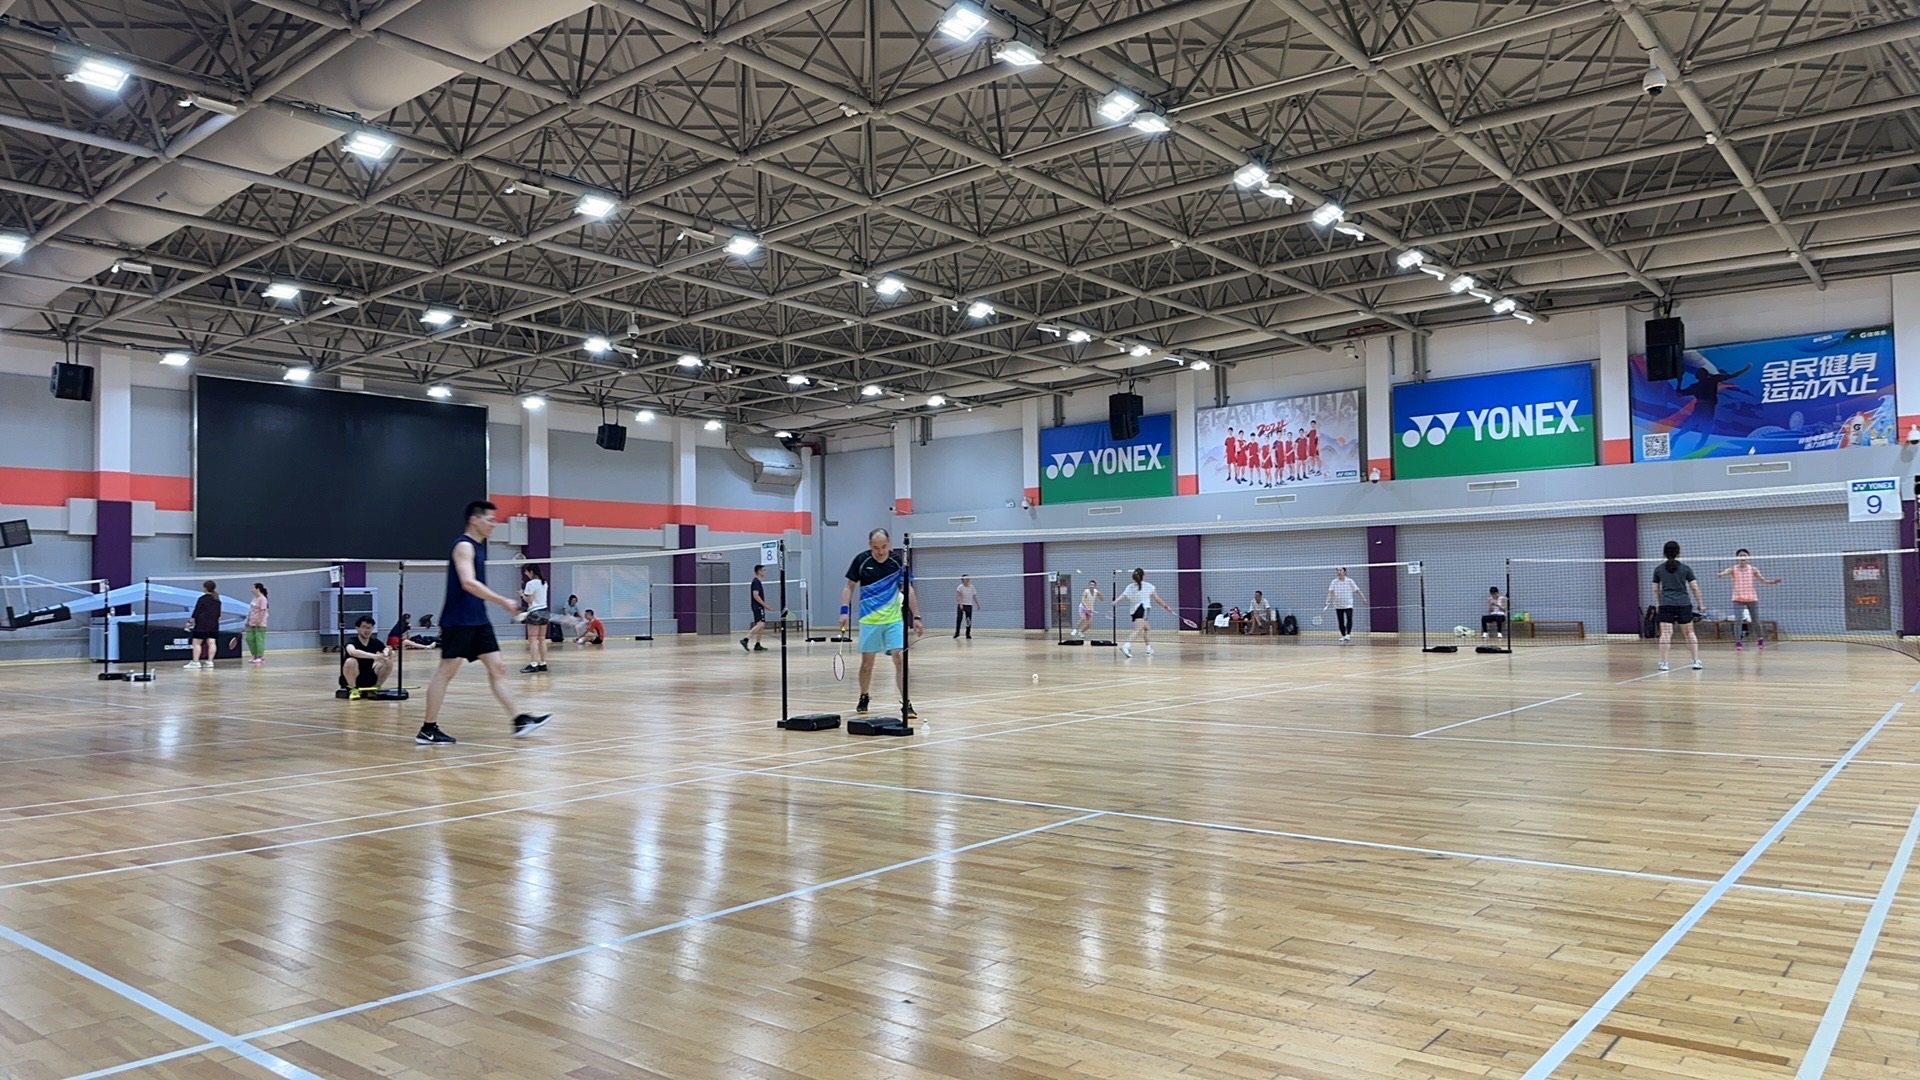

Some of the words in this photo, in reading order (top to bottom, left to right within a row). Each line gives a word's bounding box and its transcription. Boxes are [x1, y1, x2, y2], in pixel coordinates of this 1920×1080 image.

[1761, 352, 1877, 382] 全民健身
[1761, 373, 1879, 403] 运动不止
[1466, 399, 1580, 441] YONEX
[1088, 443, 1162, 475] YONEX
[1868, 481, 1893, 490] YONEX
[1867, 495, 1882, 514] 9
[767, 550, 772, 561] 8
